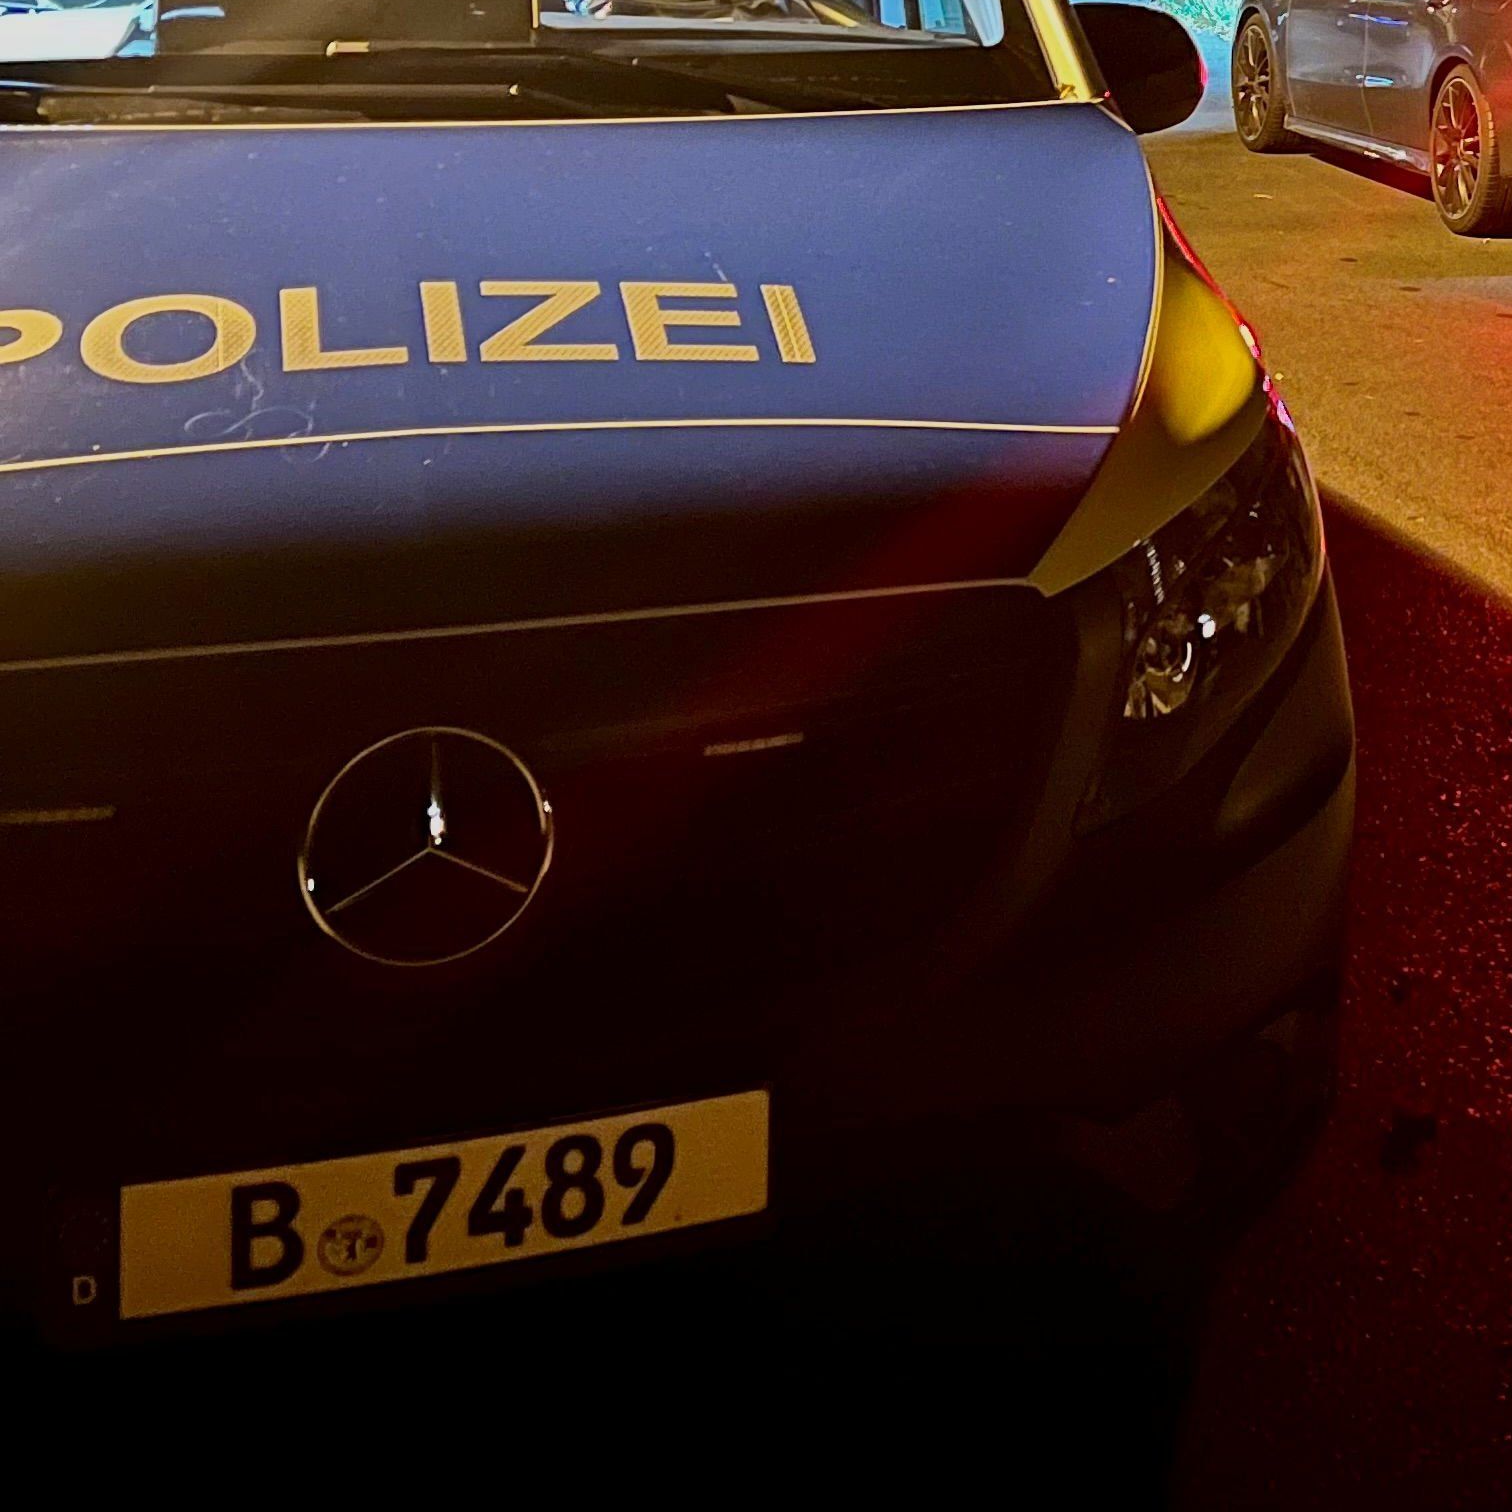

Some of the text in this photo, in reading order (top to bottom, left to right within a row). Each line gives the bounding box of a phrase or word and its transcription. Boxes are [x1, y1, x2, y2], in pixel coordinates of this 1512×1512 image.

[230, 1121, 677, 1293] B 7489
[72, 1276, 98, 1306] D
